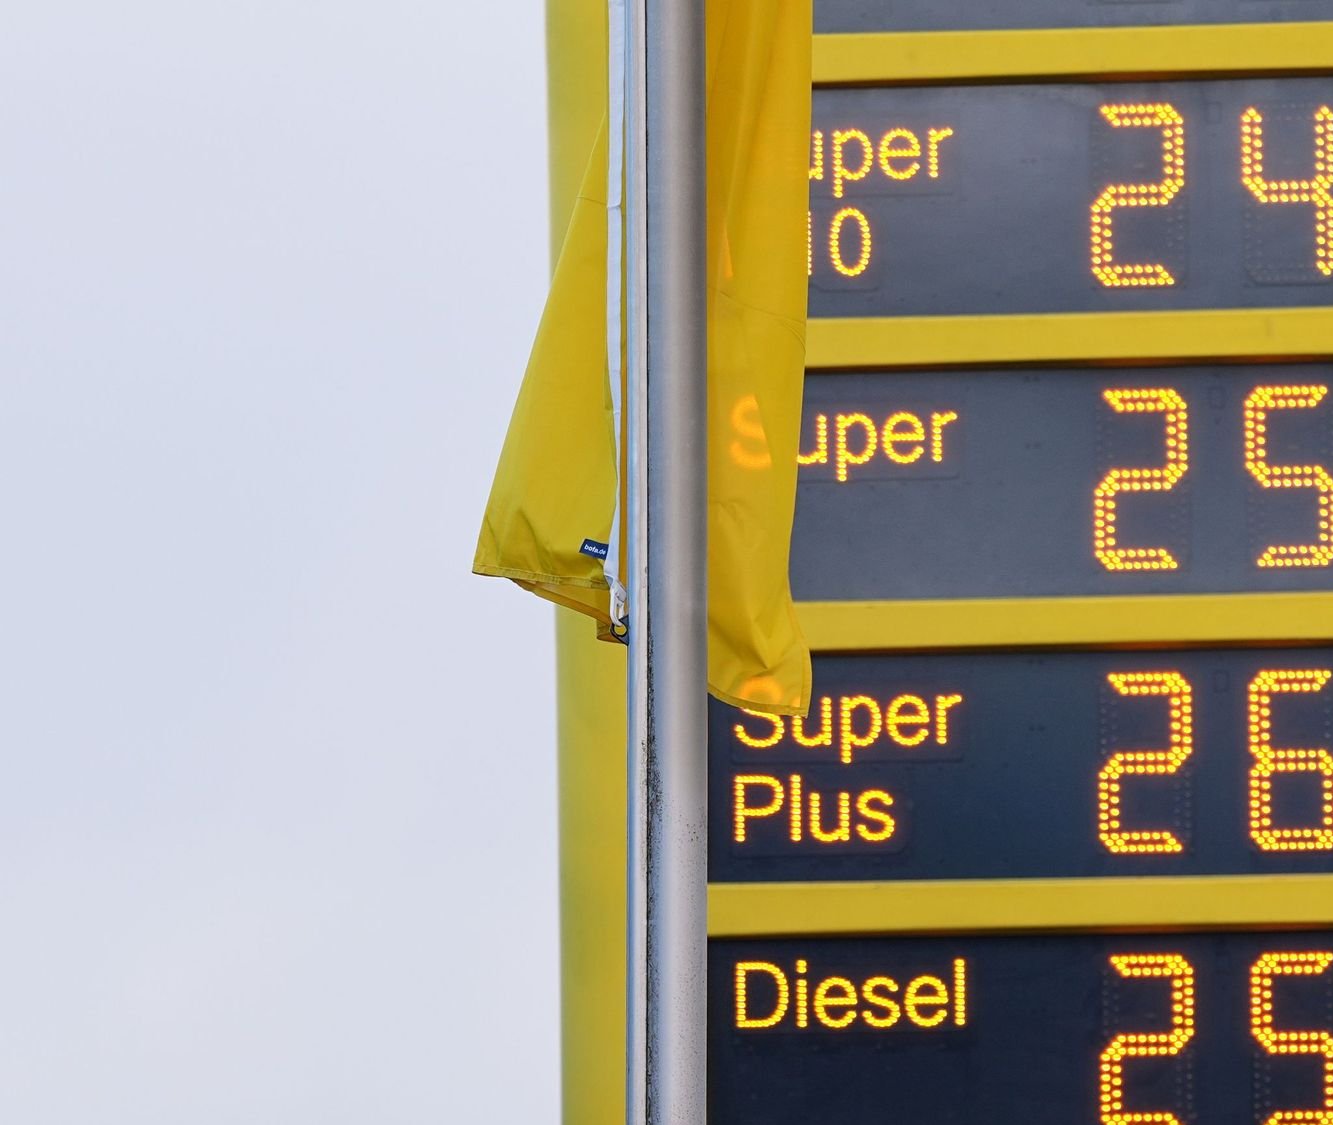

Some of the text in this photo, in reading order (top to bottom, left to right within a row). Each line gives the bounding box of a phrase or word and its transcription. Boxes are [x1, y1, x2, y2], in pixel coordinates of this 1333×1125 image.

[733, 674, 963, 765] Super
[733, 773, 896, 843] Plus
[735, 958, 967, 1029] Diesel
